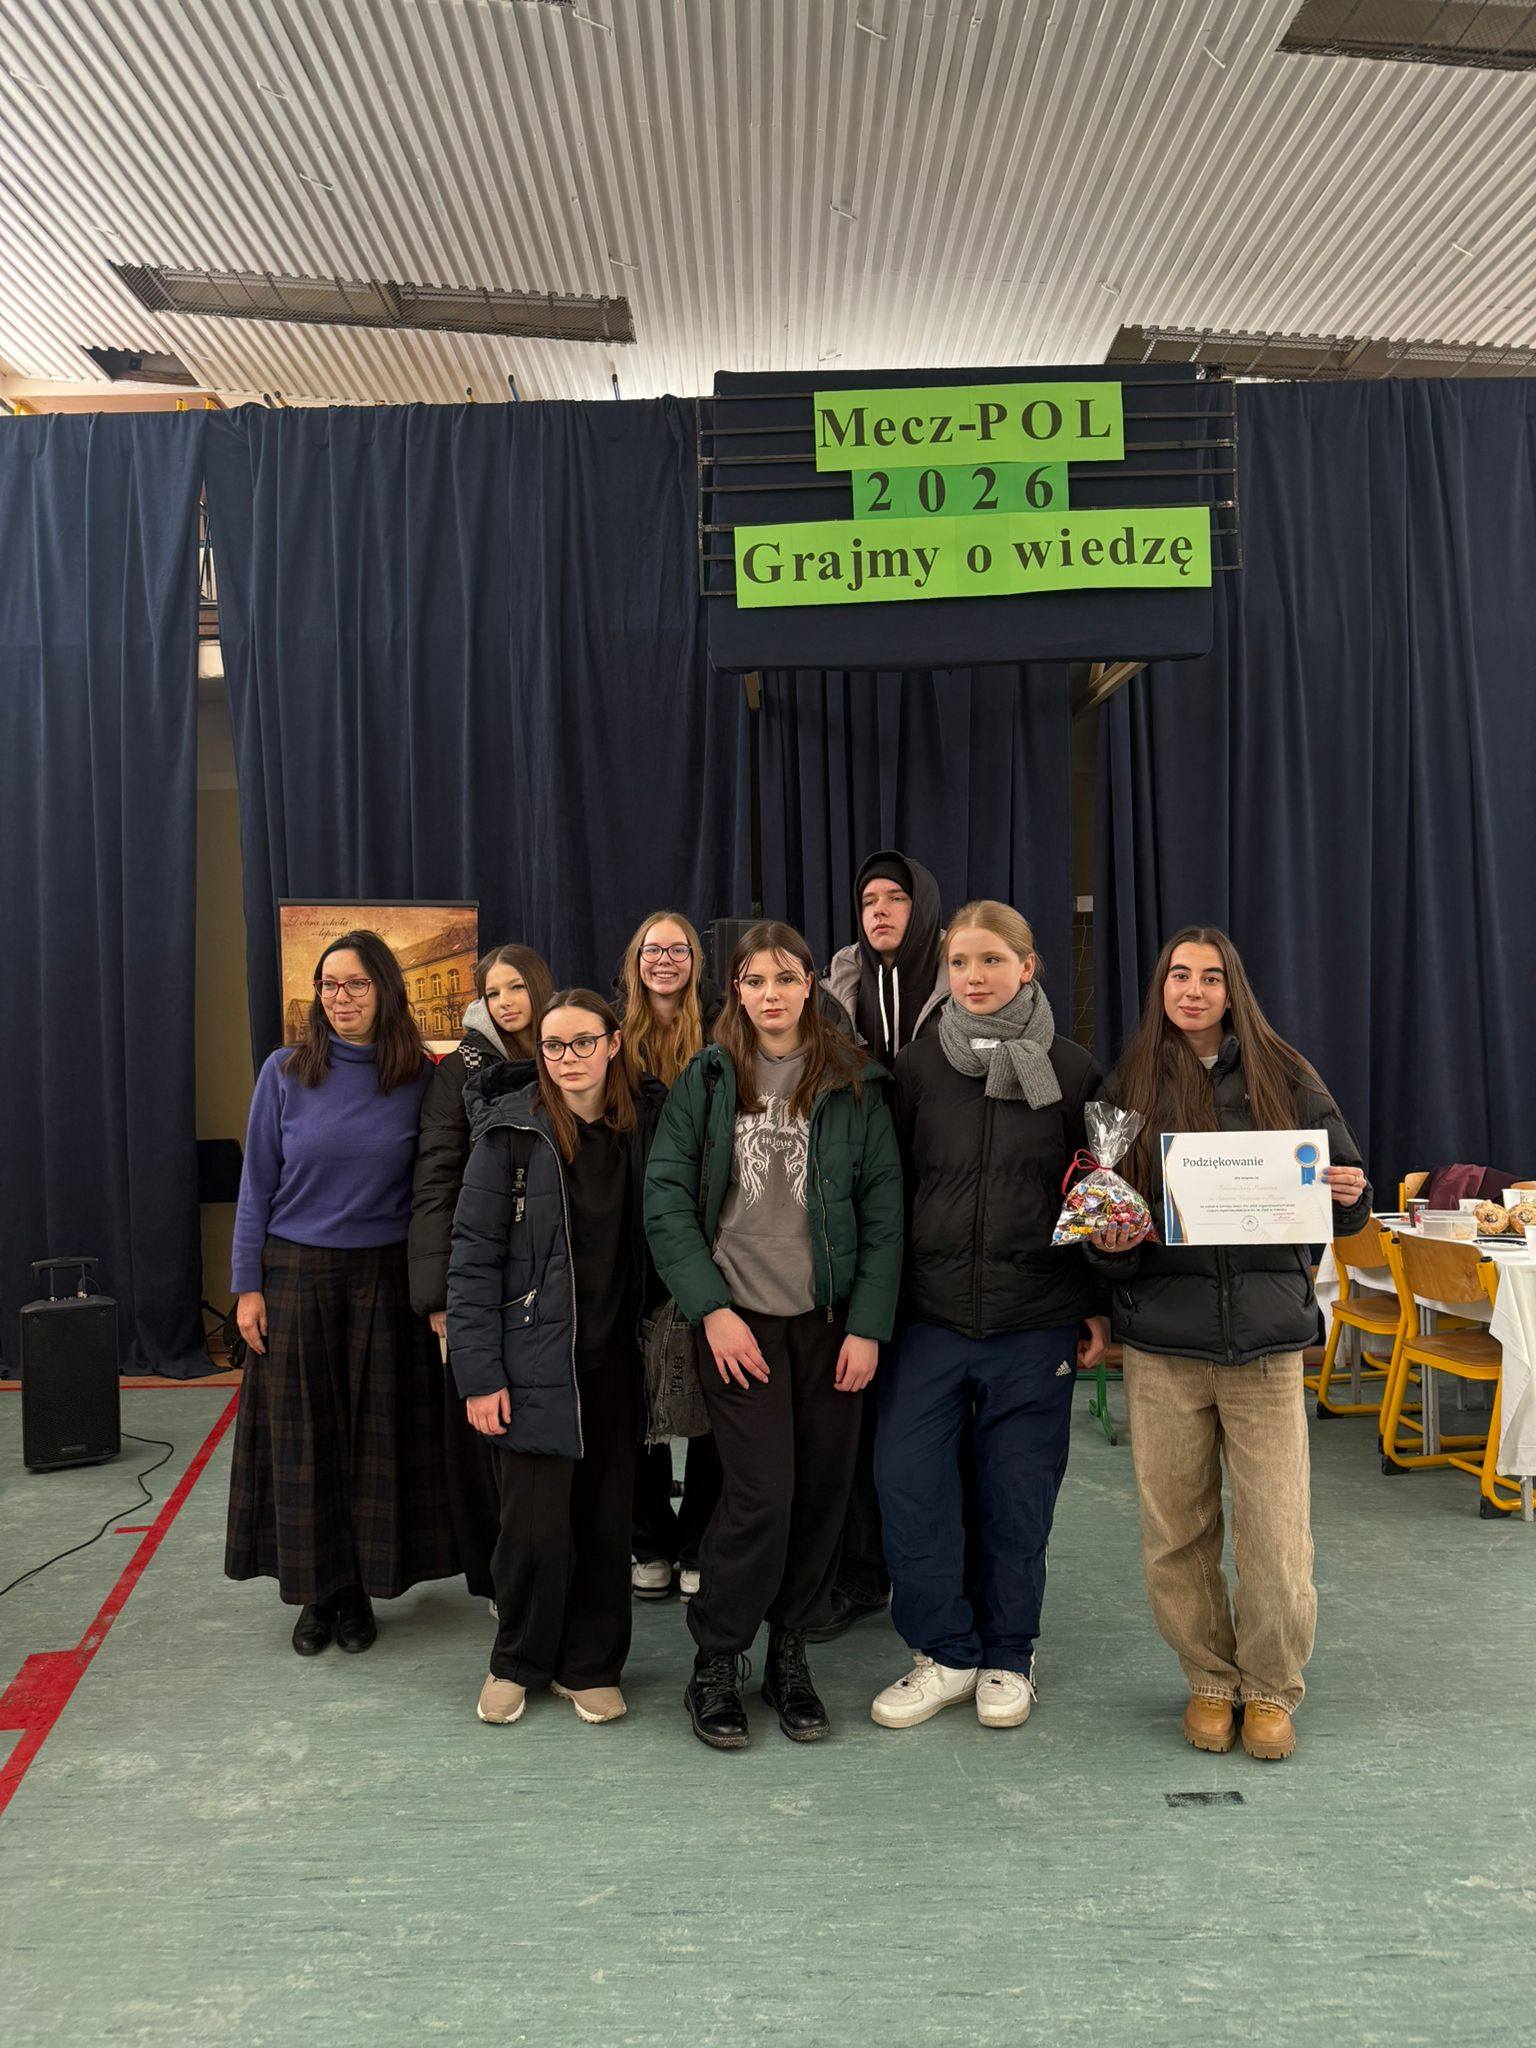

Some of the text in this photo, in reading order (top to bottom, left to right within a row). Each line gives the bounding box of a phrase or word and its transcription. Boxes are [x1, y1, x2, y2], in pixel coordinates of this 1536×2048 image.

[816, 398, 1112, 448] Mecz-POL
[866, 464, 1055, 513] 2026
[742, 526, 1194, 591] Grajmy o wiedzę
[1182, 1156, 1264, 1169] Podziękowanie
